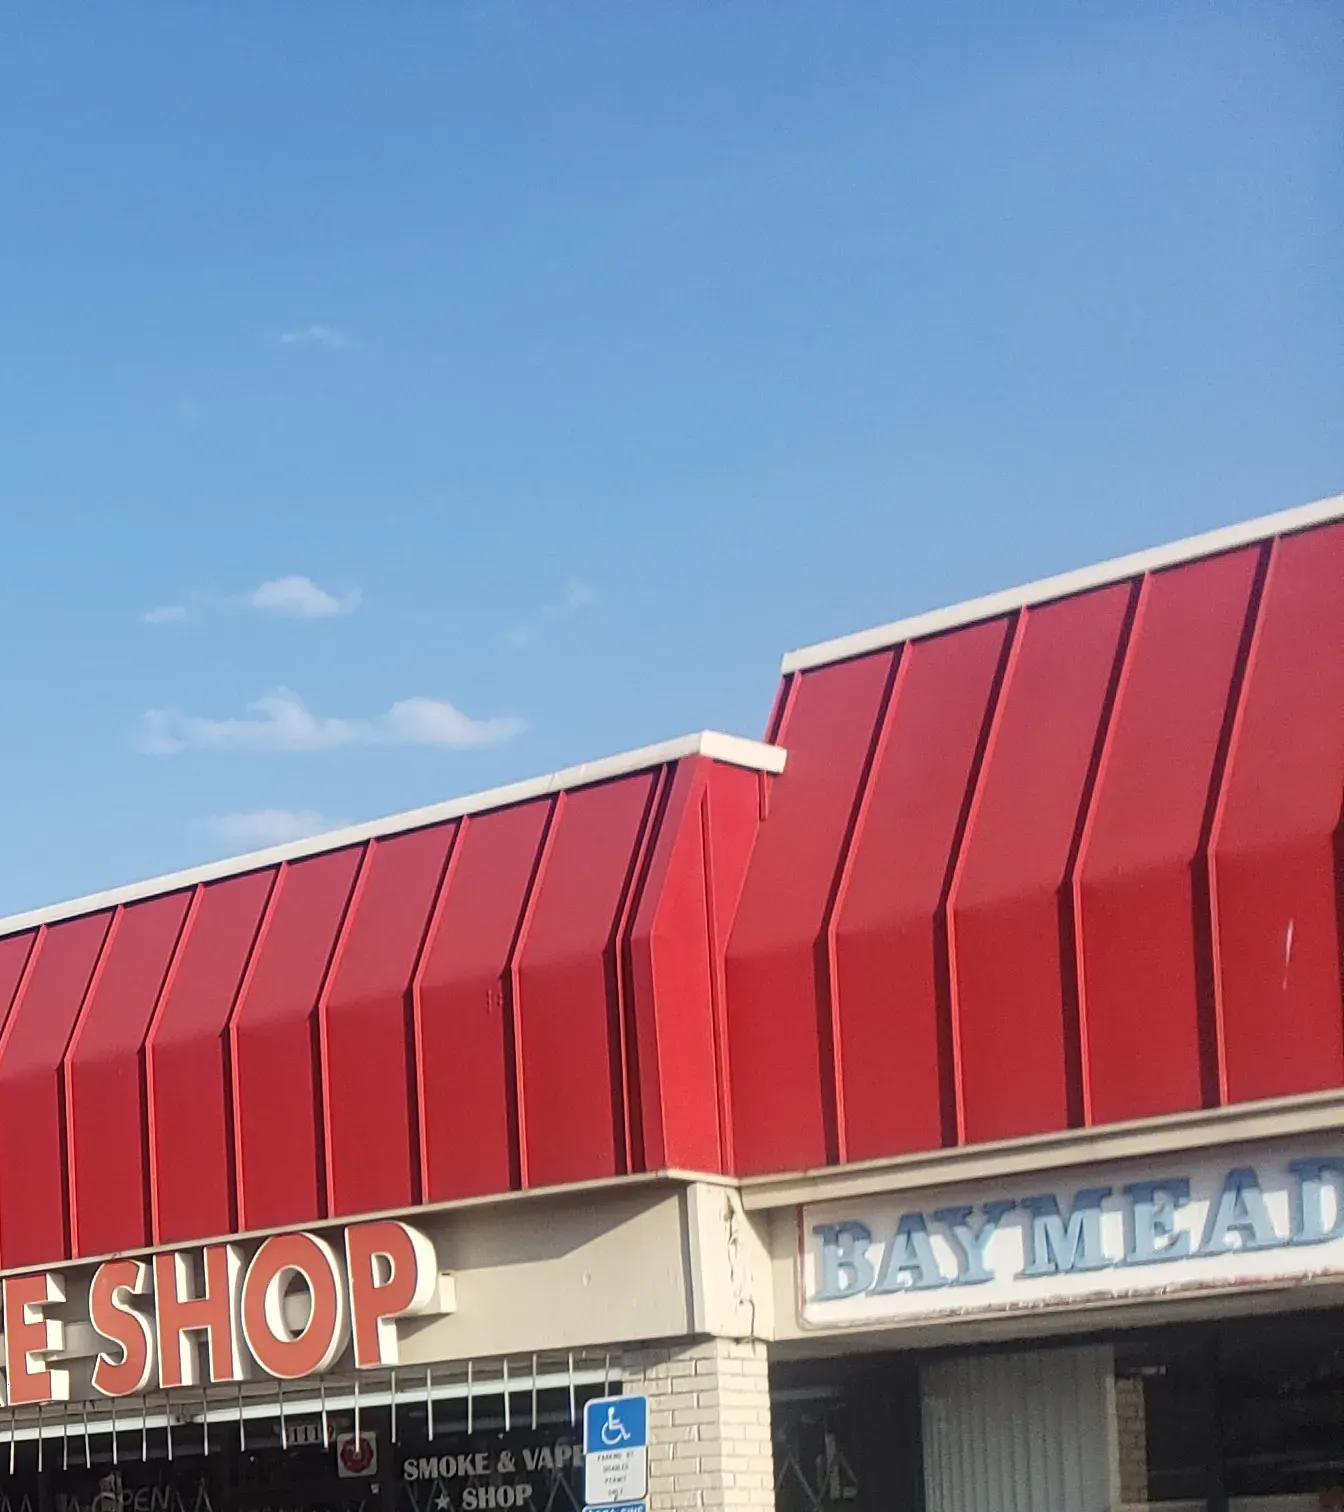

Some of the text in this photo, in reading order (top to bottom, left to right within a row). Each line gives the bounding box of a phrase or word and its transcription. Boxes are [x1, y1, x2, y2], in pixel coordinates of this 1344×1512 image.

[812, 1155, 1344, 1301] BAYMEAD
[90, 1220, 437, 1397] SHOP
[404, 1444, 584, 1481] SMOKE & VAPE
[463, 1484, 532, 1510] SHOP
